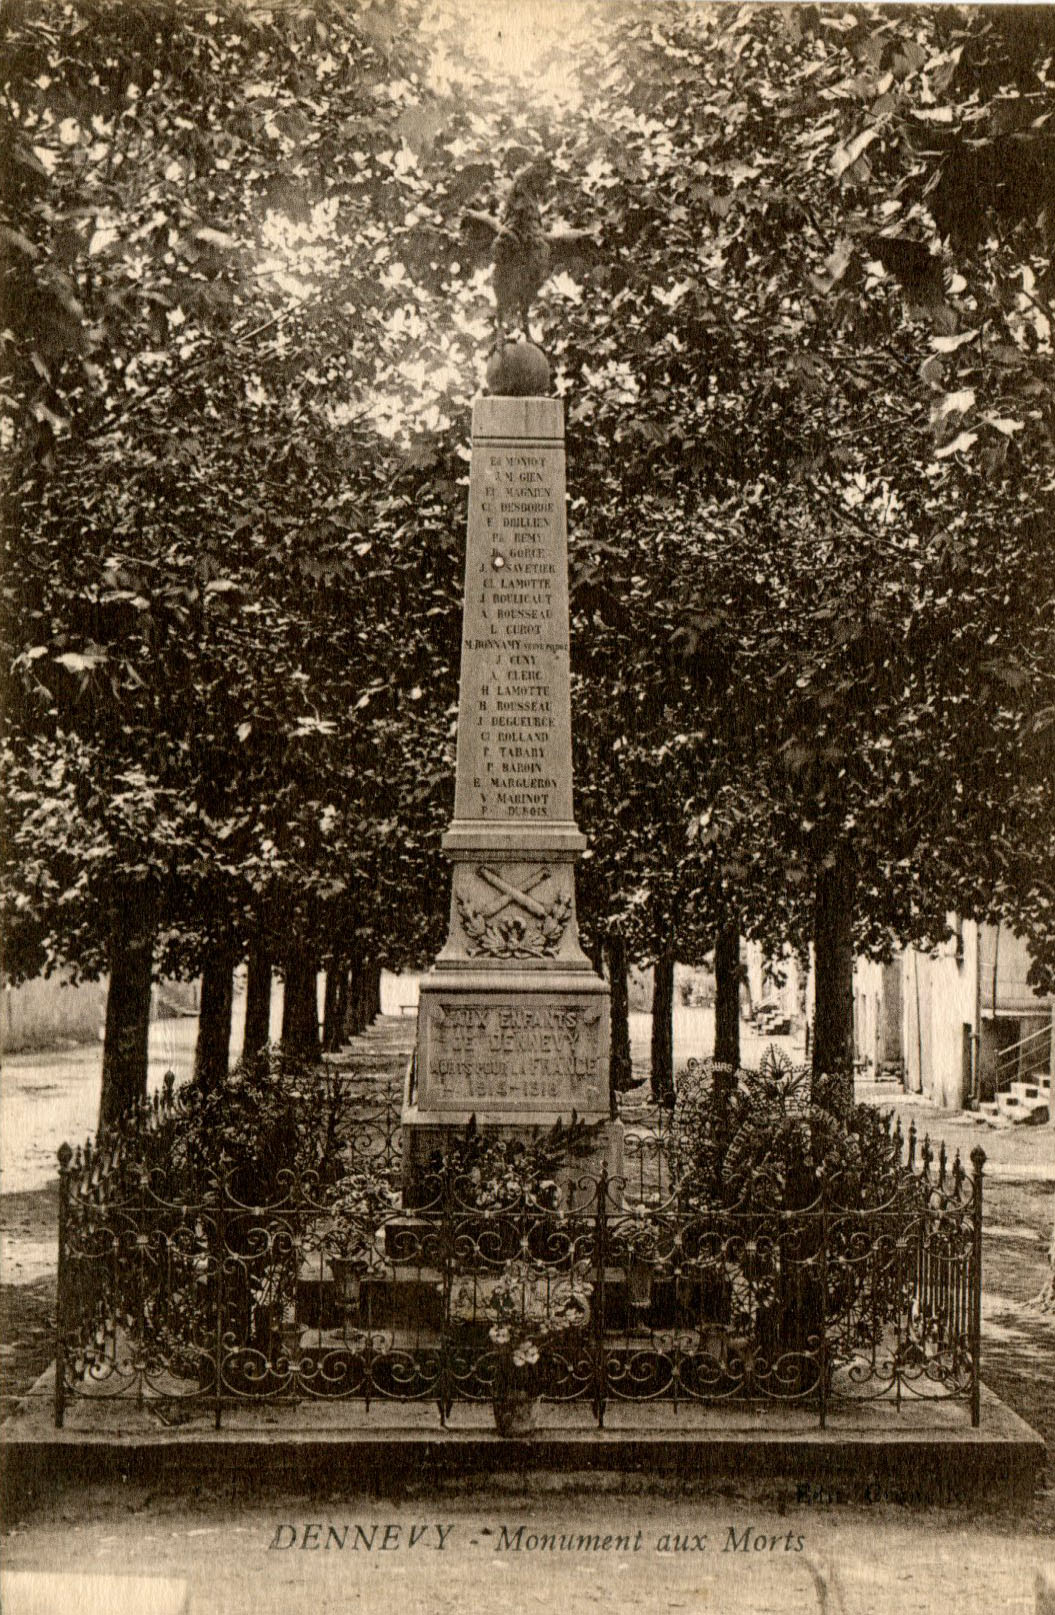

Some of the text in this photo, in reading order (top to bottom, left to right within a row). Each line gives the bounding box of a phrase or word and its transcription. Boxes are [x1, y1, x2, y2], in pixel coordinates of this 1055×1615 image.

[501, 578, 551, 589] LAMOTTE
[497, 609, 553, 619] ROUSSEAU
[497, 685, 550, 696] LAMOTTE
[496, 701, 552, 712] ROUSSEAU
[498, 732, 549, 741] ROLLAND
[450, 1010, 577, 1028] AUX ENFANTS
[490, 1031, 578, 1051] DENNEVY
